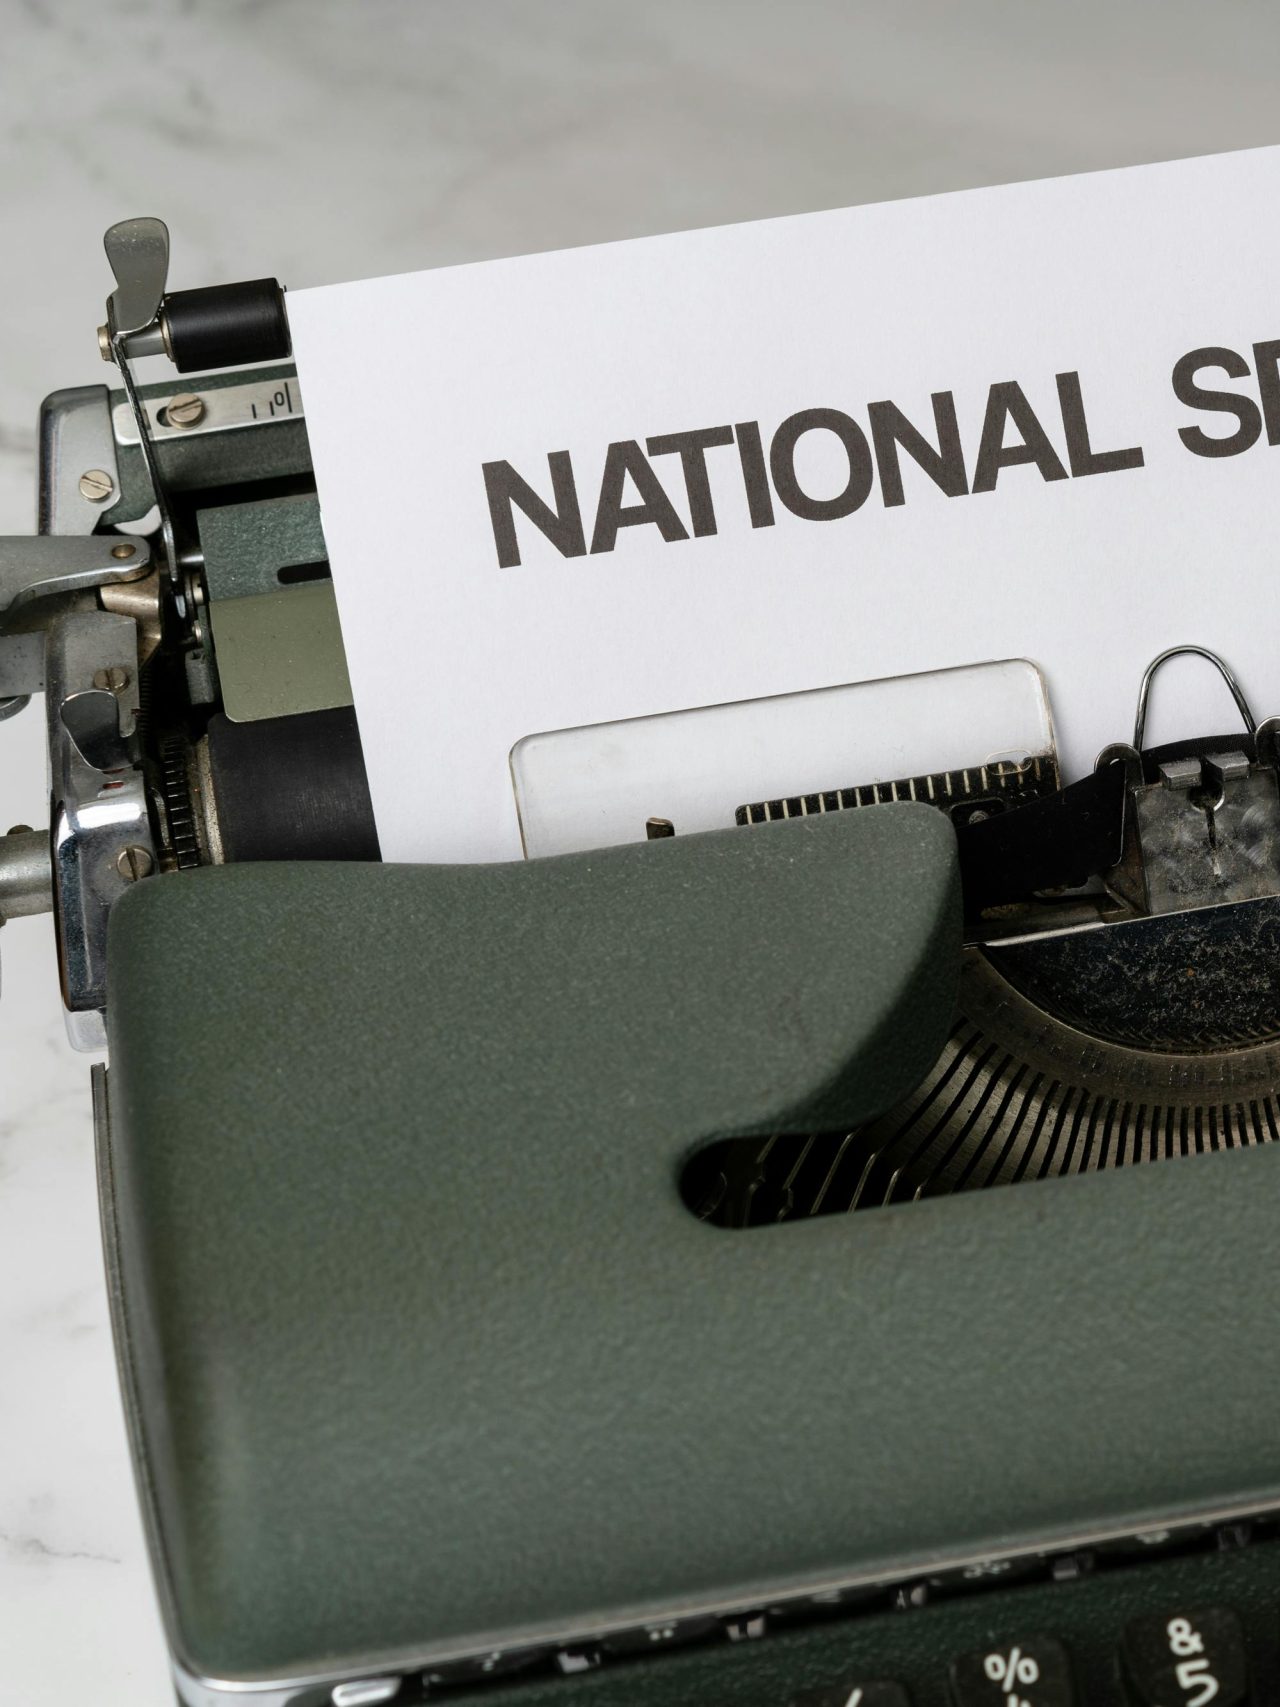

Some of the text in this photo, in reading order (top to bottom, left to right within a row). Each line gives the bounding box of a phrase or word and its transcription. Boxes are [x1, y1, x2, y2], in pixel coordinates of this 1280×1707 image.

[482, 371, 1144, 568] NATIONAL
[1166, 1617, 1204, 1656] &
[983, 1646, 1040, 1693] %
[1175, 1659, 1219, 1707] 5
